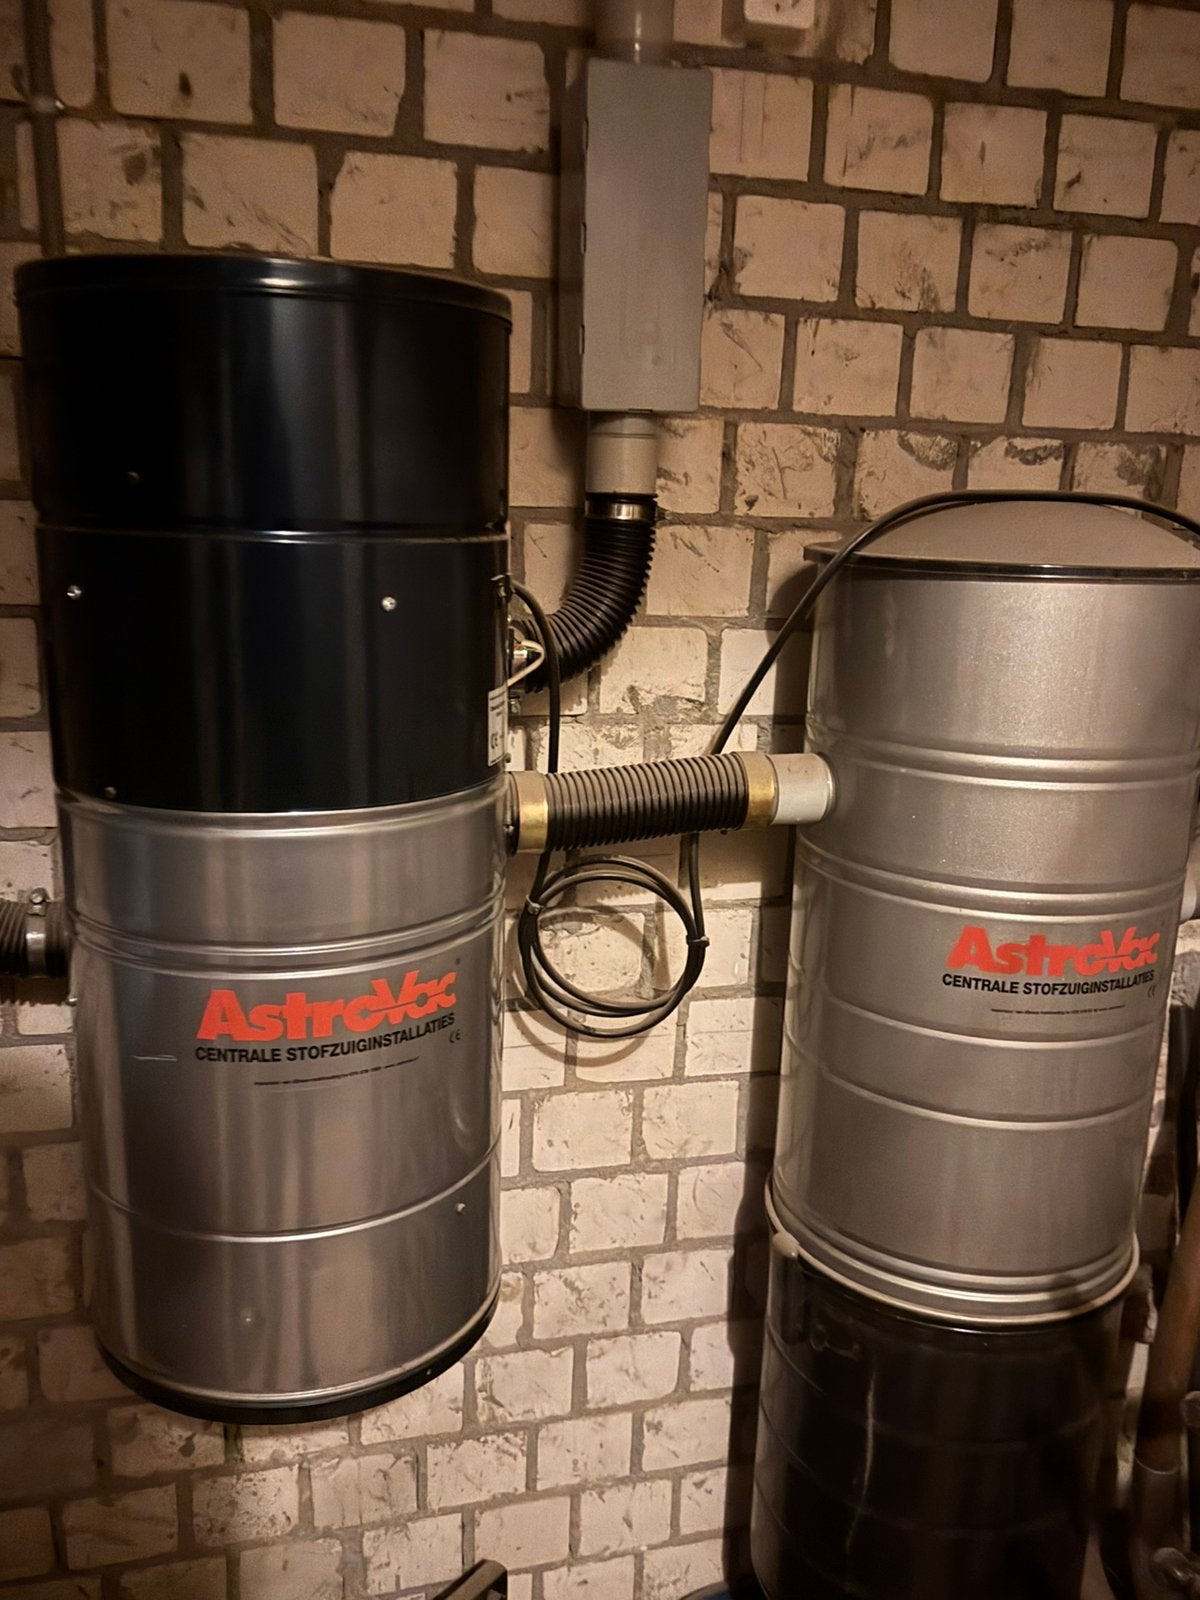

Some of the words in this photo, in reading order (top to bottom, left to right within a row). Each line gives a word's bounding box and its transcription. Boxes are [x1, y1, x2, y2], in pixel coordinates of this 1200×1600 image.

[946, 925, 1160, 977] AstroVac
[195, 970, 457, 1041] AstroVac
[942, 973, 1018, 994] CENTRALE
[1022, 969, 1154, 995] STOFZUIGINSTALLATIES
[195, 1046, 282, 1063] CENTRALE
[286, 1012, 455, 1062] STOFZUIGINSTALLATIES
